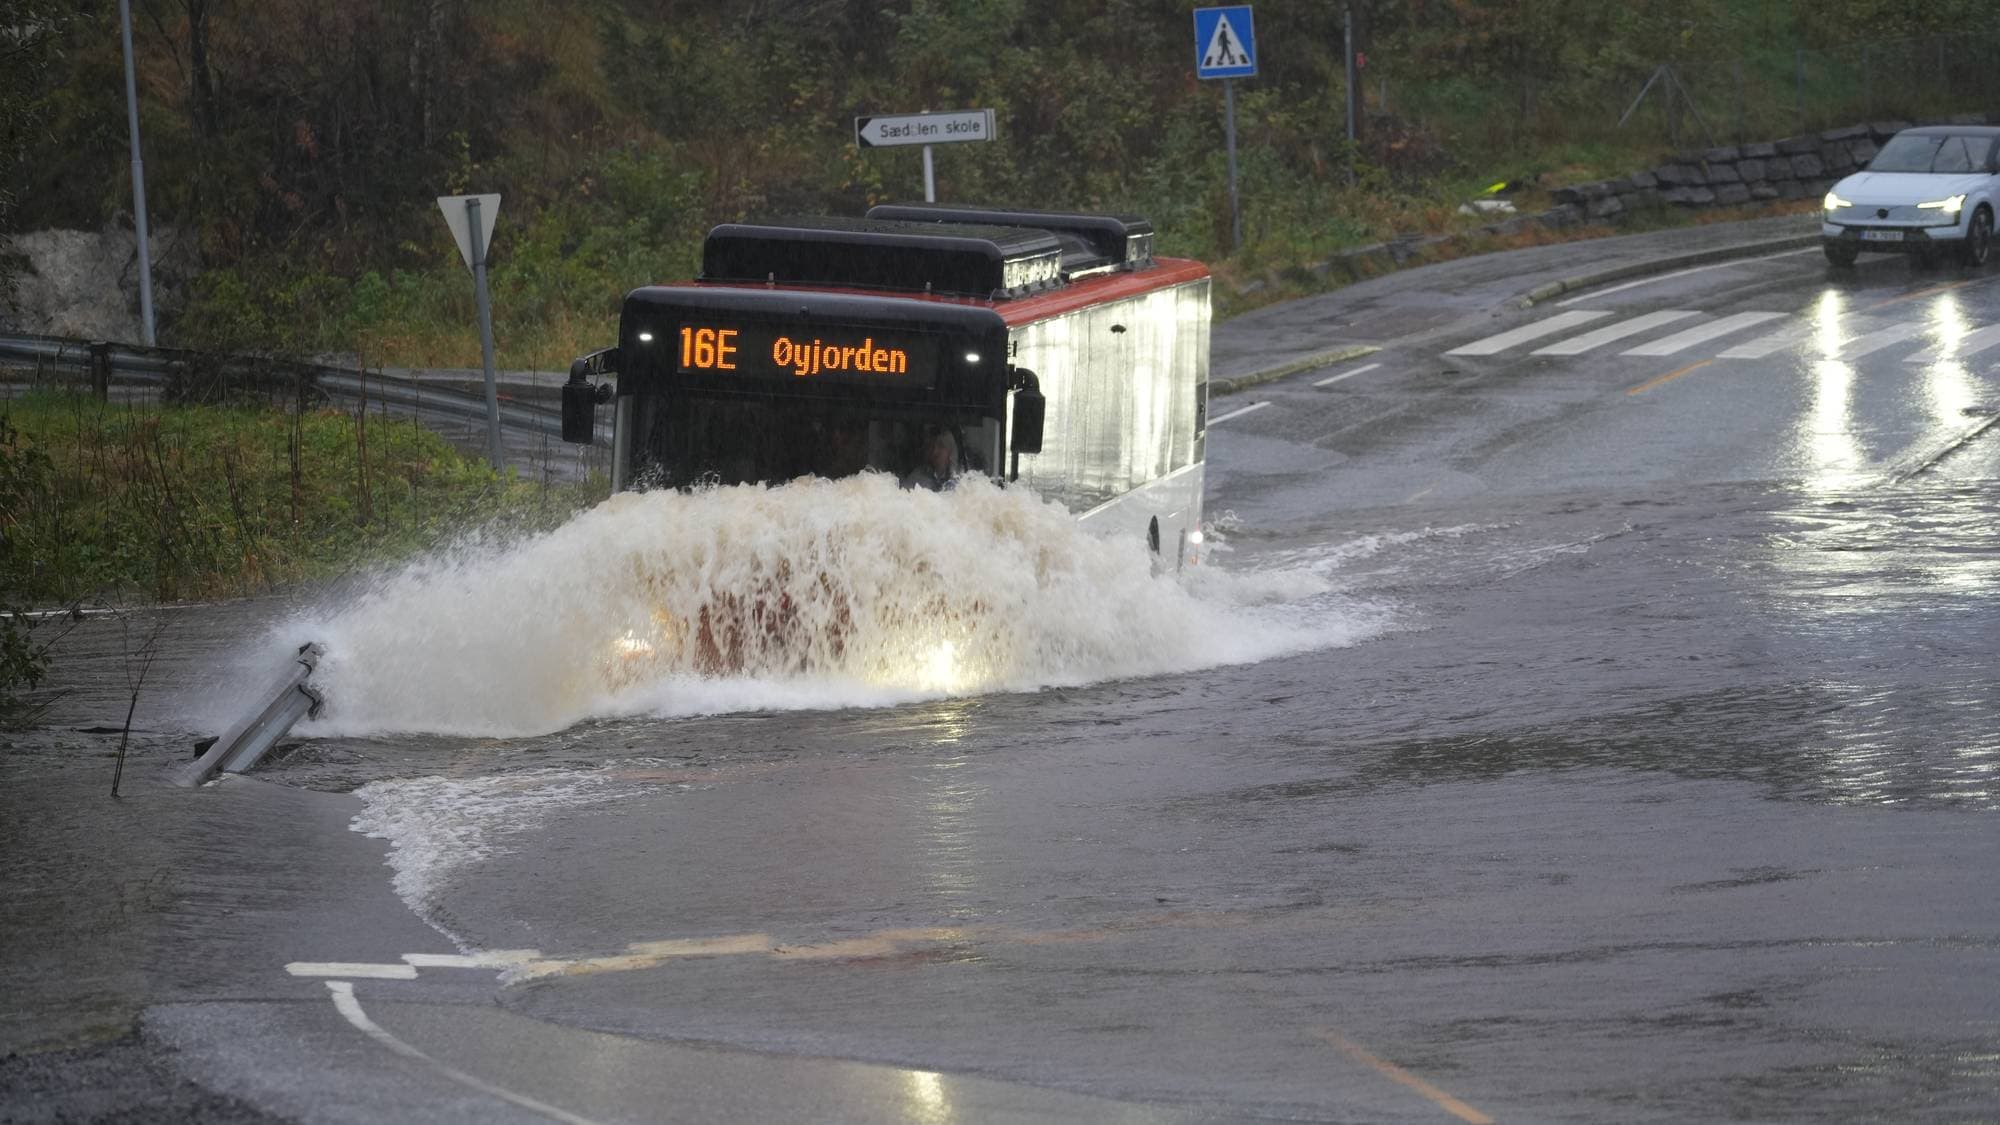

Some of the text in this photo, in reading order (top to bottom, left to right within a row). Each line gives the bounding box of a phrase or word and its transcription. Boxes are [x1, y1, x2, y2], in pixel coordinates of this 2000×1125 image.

[880, 120, 980, 138] Sædlen skole
[681, 327, 907, 376] 16E Øyjorden
